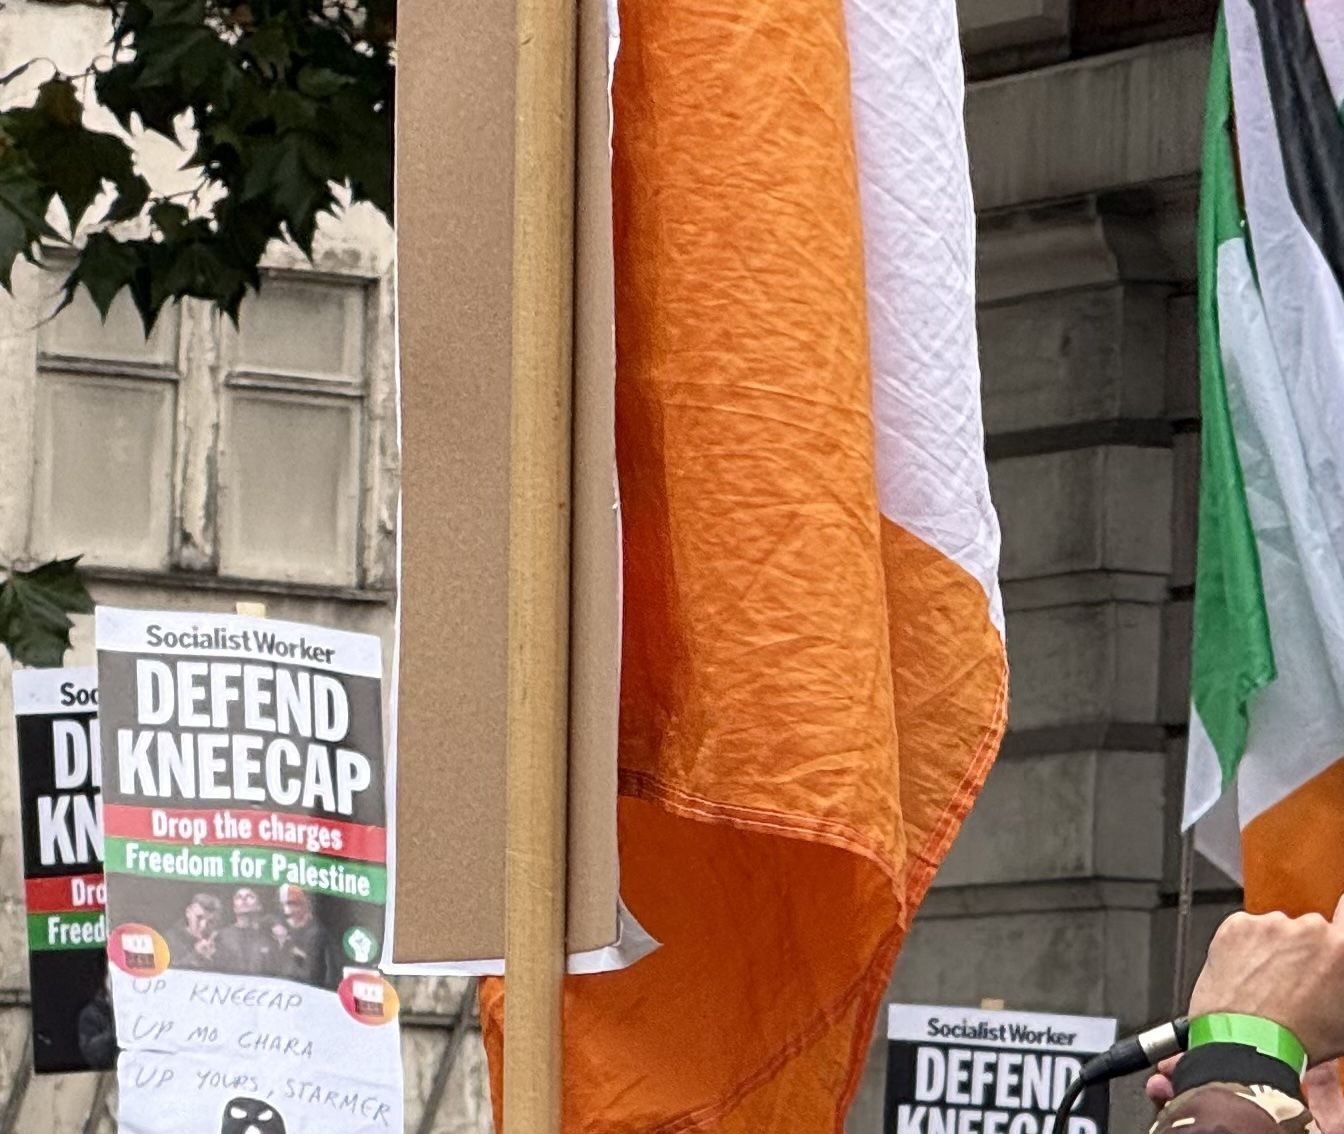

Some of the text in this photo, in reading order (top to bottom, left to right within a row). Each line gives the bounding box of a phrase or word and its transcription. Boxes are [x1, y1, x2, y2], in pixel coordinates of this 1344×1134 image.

[146, 625, 336, 664] Socialist Worker
[136, 659, 349, 744] DEFEND
[117, 728, 371, 816] KNEECAP
[151, 809, 343, 852] Drop the charges
[126, 843, 370, 897] Freedom for Palestine
[189, 985, 303, 1010] KNEECAP
[131, 1015, 314, 1057] UP MO CHARA
[928, 1017, 1078, 1047] Socialist Worker
[135, 1066, 175, 1088] UP
[284, 1079, 392, 1126] STARMER
[915, 1046, 1085, 1112] DEFEND
